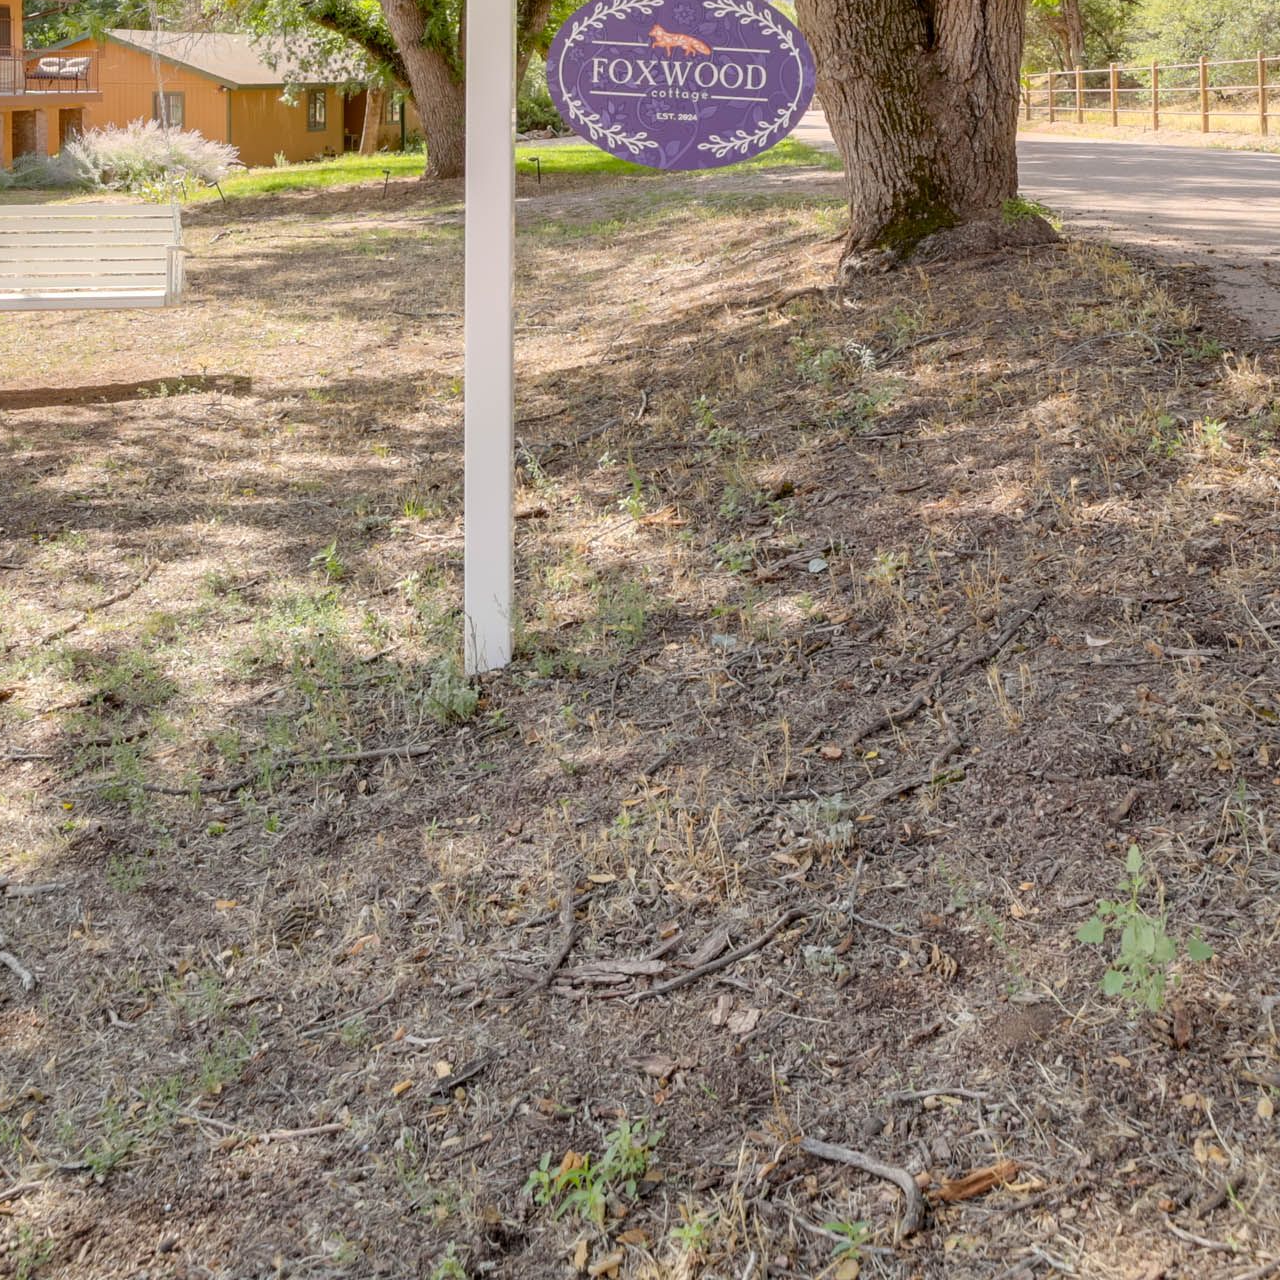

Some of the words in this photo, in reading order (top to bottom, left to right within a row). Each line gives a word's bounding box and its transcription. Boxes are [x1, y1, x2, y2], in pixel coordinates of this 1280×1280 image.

[591, 57, 767, 90] FOXWOOD
[651, 88, 709, 102] cottage
[656, 112, 676, 120] EST.
